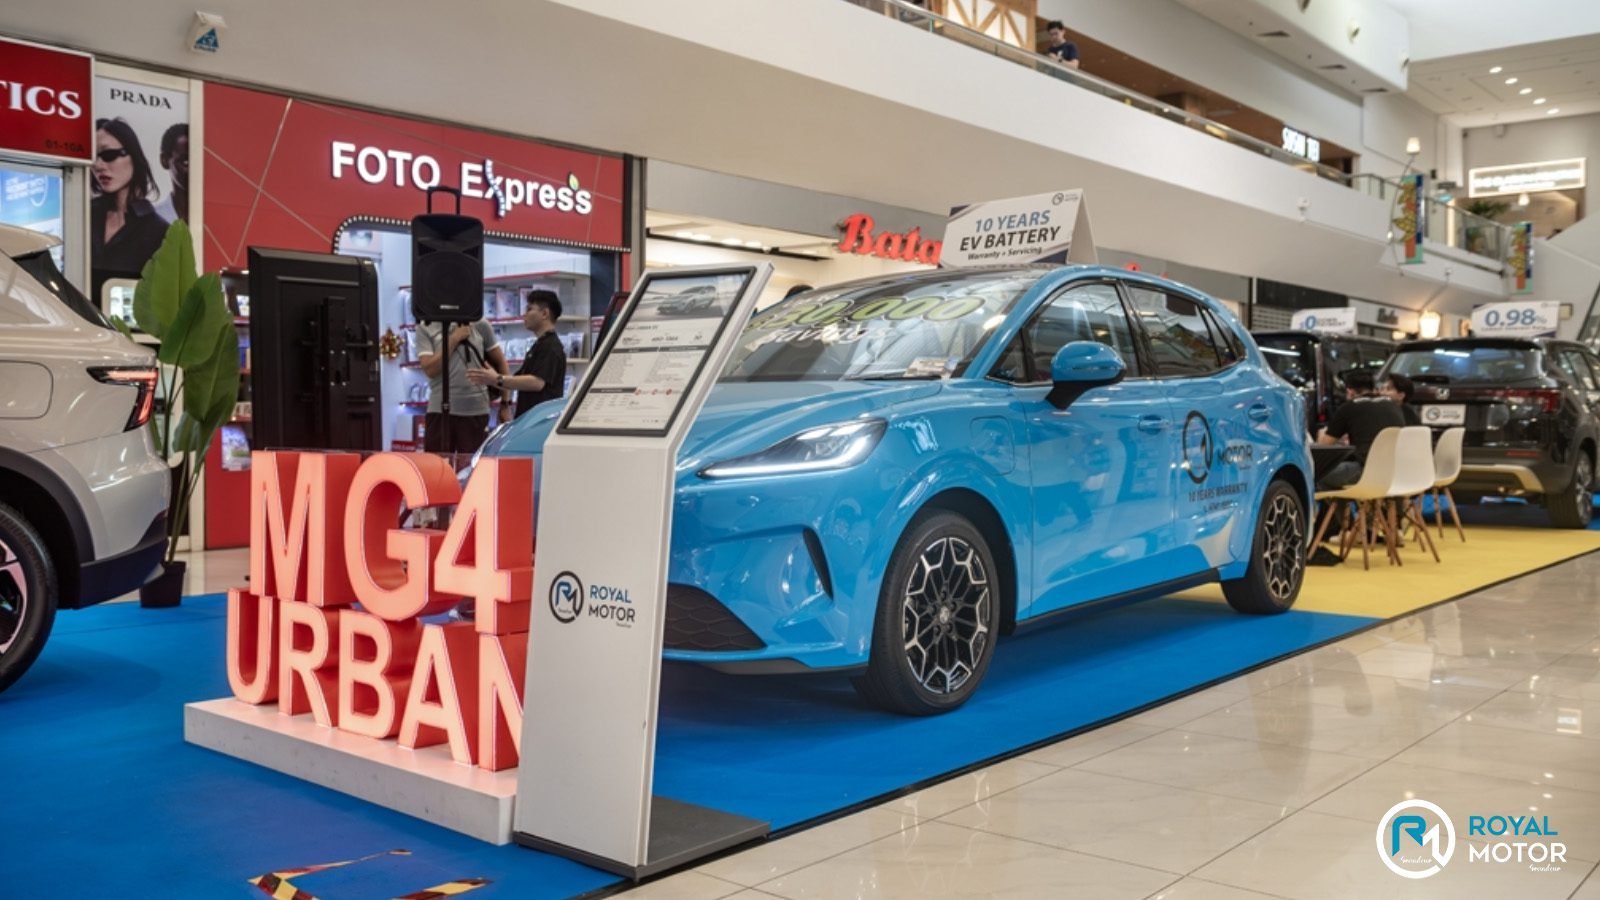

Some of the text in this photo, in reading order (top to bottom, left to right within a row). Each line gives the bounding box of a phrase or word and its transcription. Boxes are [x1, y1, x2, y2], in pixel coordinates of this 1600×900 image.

[109, 87, 173, 110] PRADA
[331, 141, 593, 218] FOTO Express
[975, 209, 1051, 233] 10 YEARS
[834, 212, 943, 265] Bata
[960, 226, 1062, 251] EV BATTERY
[967, 250, 1001, 260] Warranty
[1007, 247, 1042, 257] Servicing
[1217, 445, 1253, 465] MOTOR
[250, 450, 534, 634] MG4
[589, 585, 632, 604] ROYAL
[588, 604, 636, 622] MOTOR
[226, 588, 524, 772] URBAN
